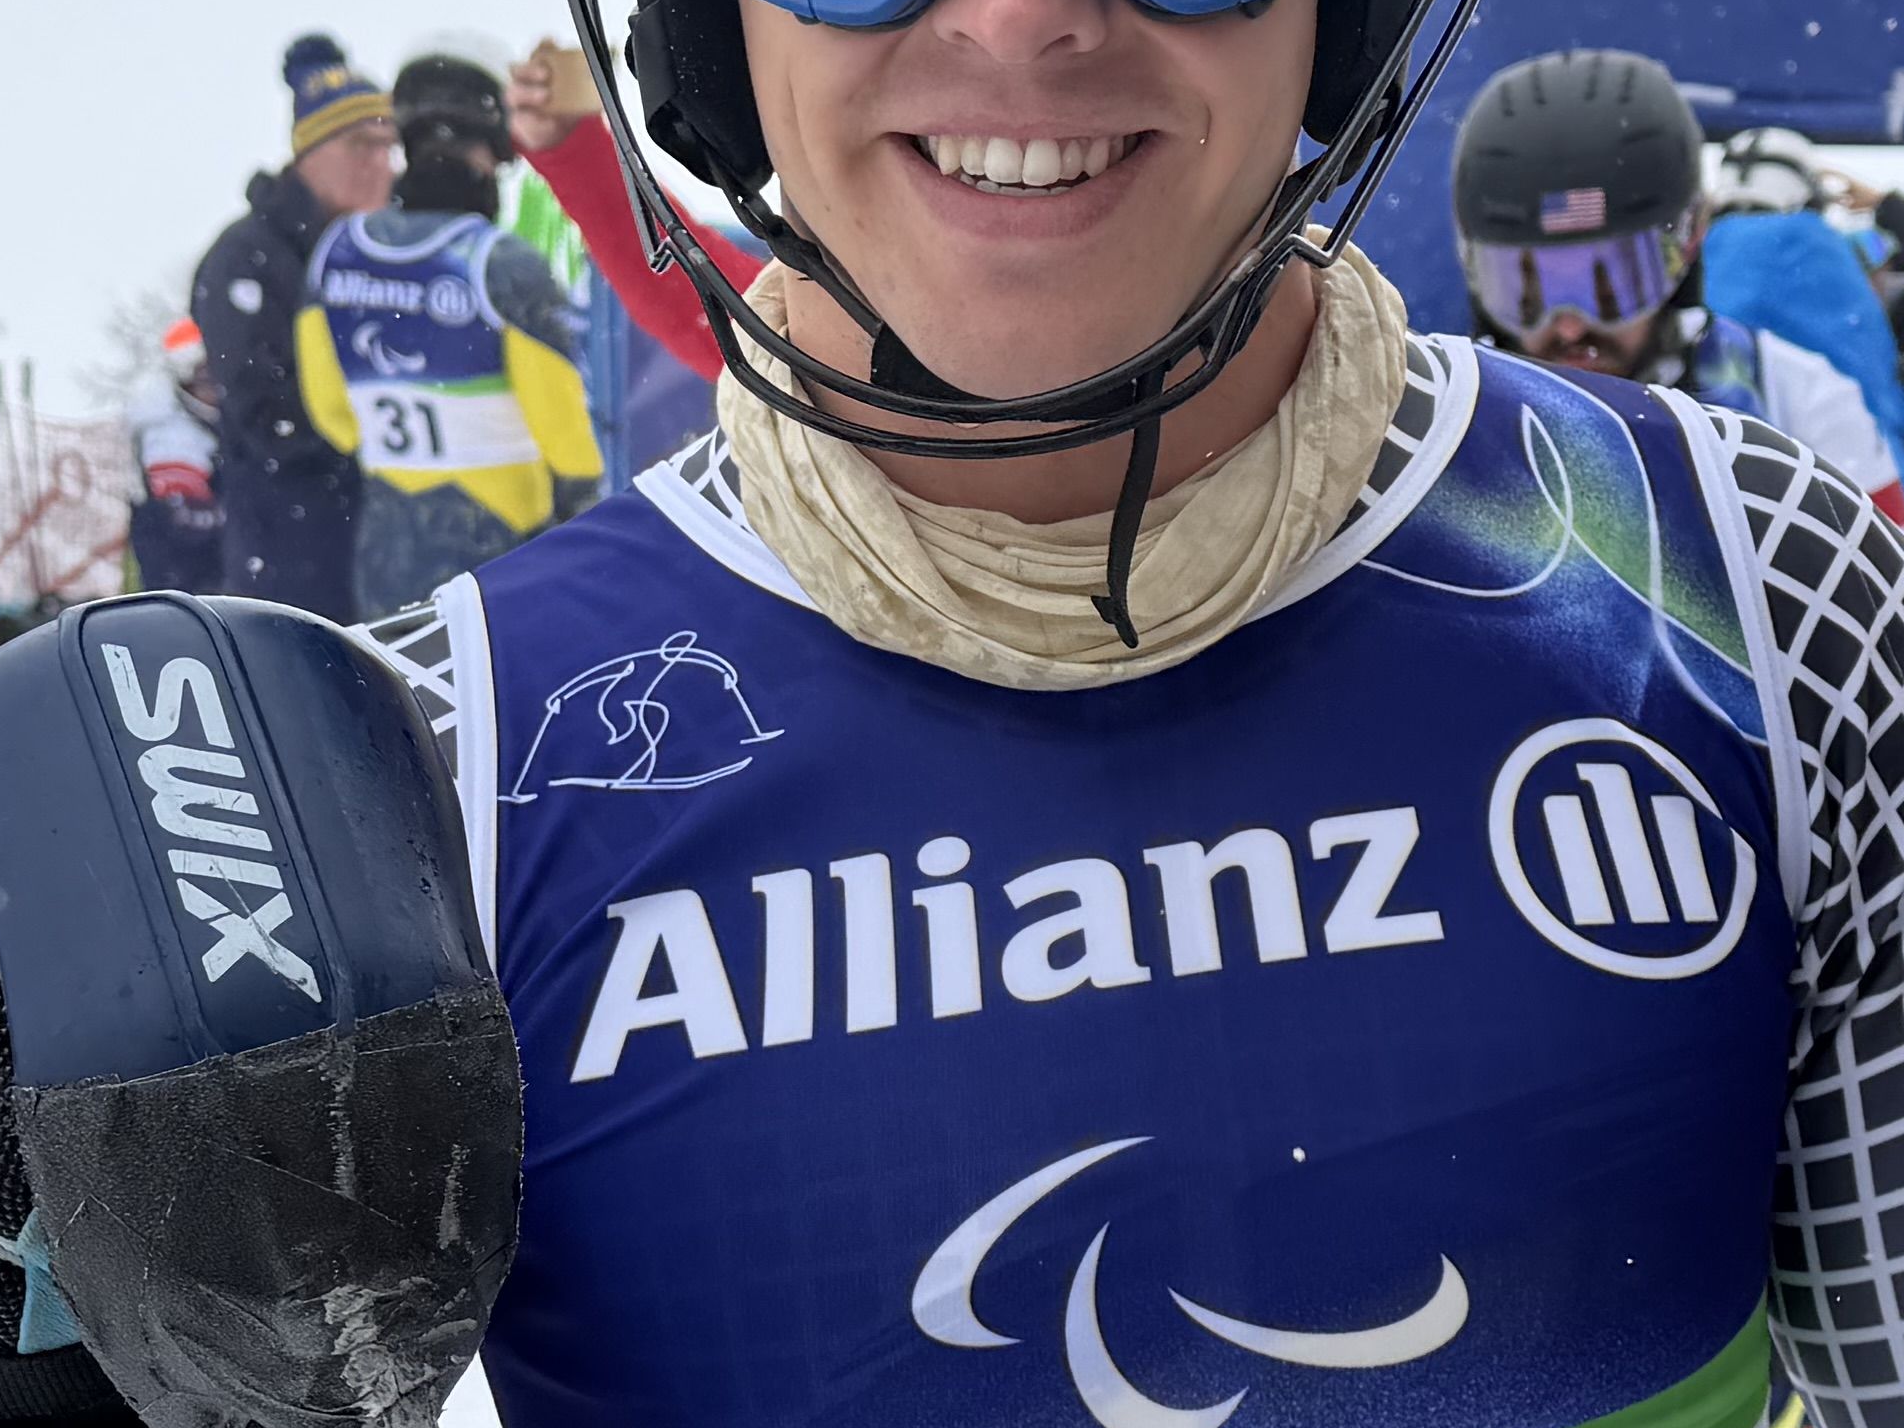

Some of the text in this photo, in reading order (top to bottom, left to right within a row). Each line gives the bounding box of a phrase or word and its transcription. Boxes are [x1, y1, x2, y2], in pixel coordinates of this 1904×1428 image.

[324, 269, 425, 314] Allianz
[375, 397, 442, 459] 31
[101, 643, 321, 1003] SWIX
[568, 804, 1446, 1083] Allianz
